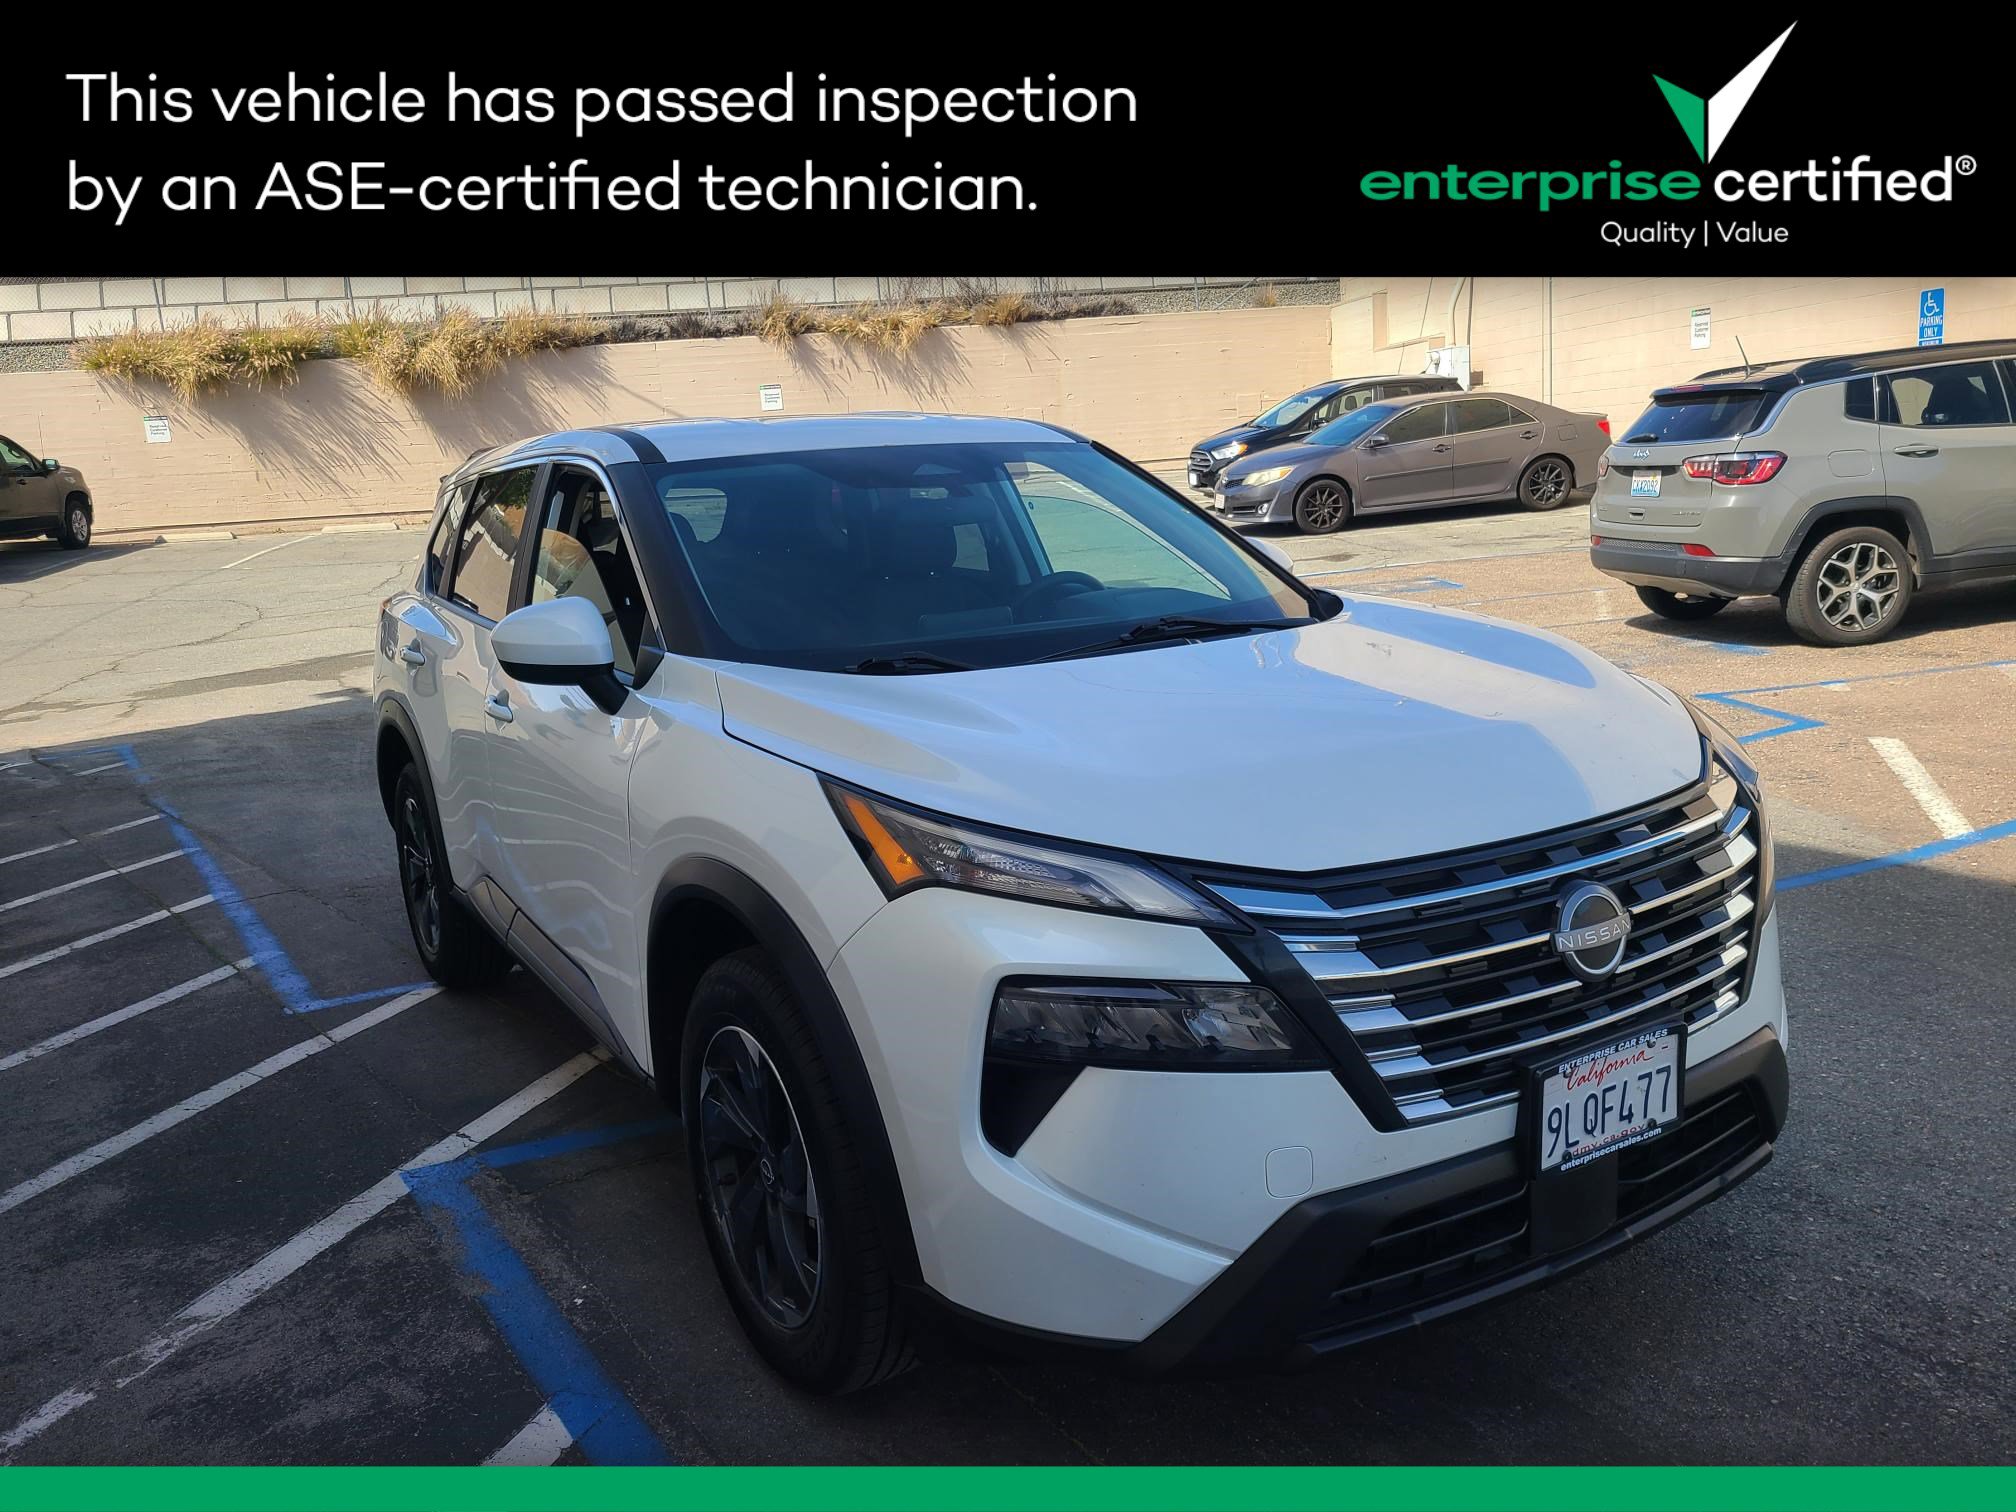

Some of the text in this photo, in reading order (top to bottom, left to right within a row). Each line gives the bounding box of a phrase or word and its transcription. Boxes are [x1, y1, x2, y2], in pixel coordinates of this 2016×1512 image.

[1920, 314, 1943, 328] PARKING
[1923, 326, 1938, 338] ONLY
[1558, 919, 1630, 949] NISSAN
[1558, 1028, 1668, 1074] ENTERPRISE CAR SALES
[1566, 1049, 1654, 1091] California
[1547, 1064, 1672, 1158] 9LQF477
[1560, 1126, 1662, 1172] enterprisecarsales.com
[1572, 1123, 1646, 1157] dmv.ca.gov
